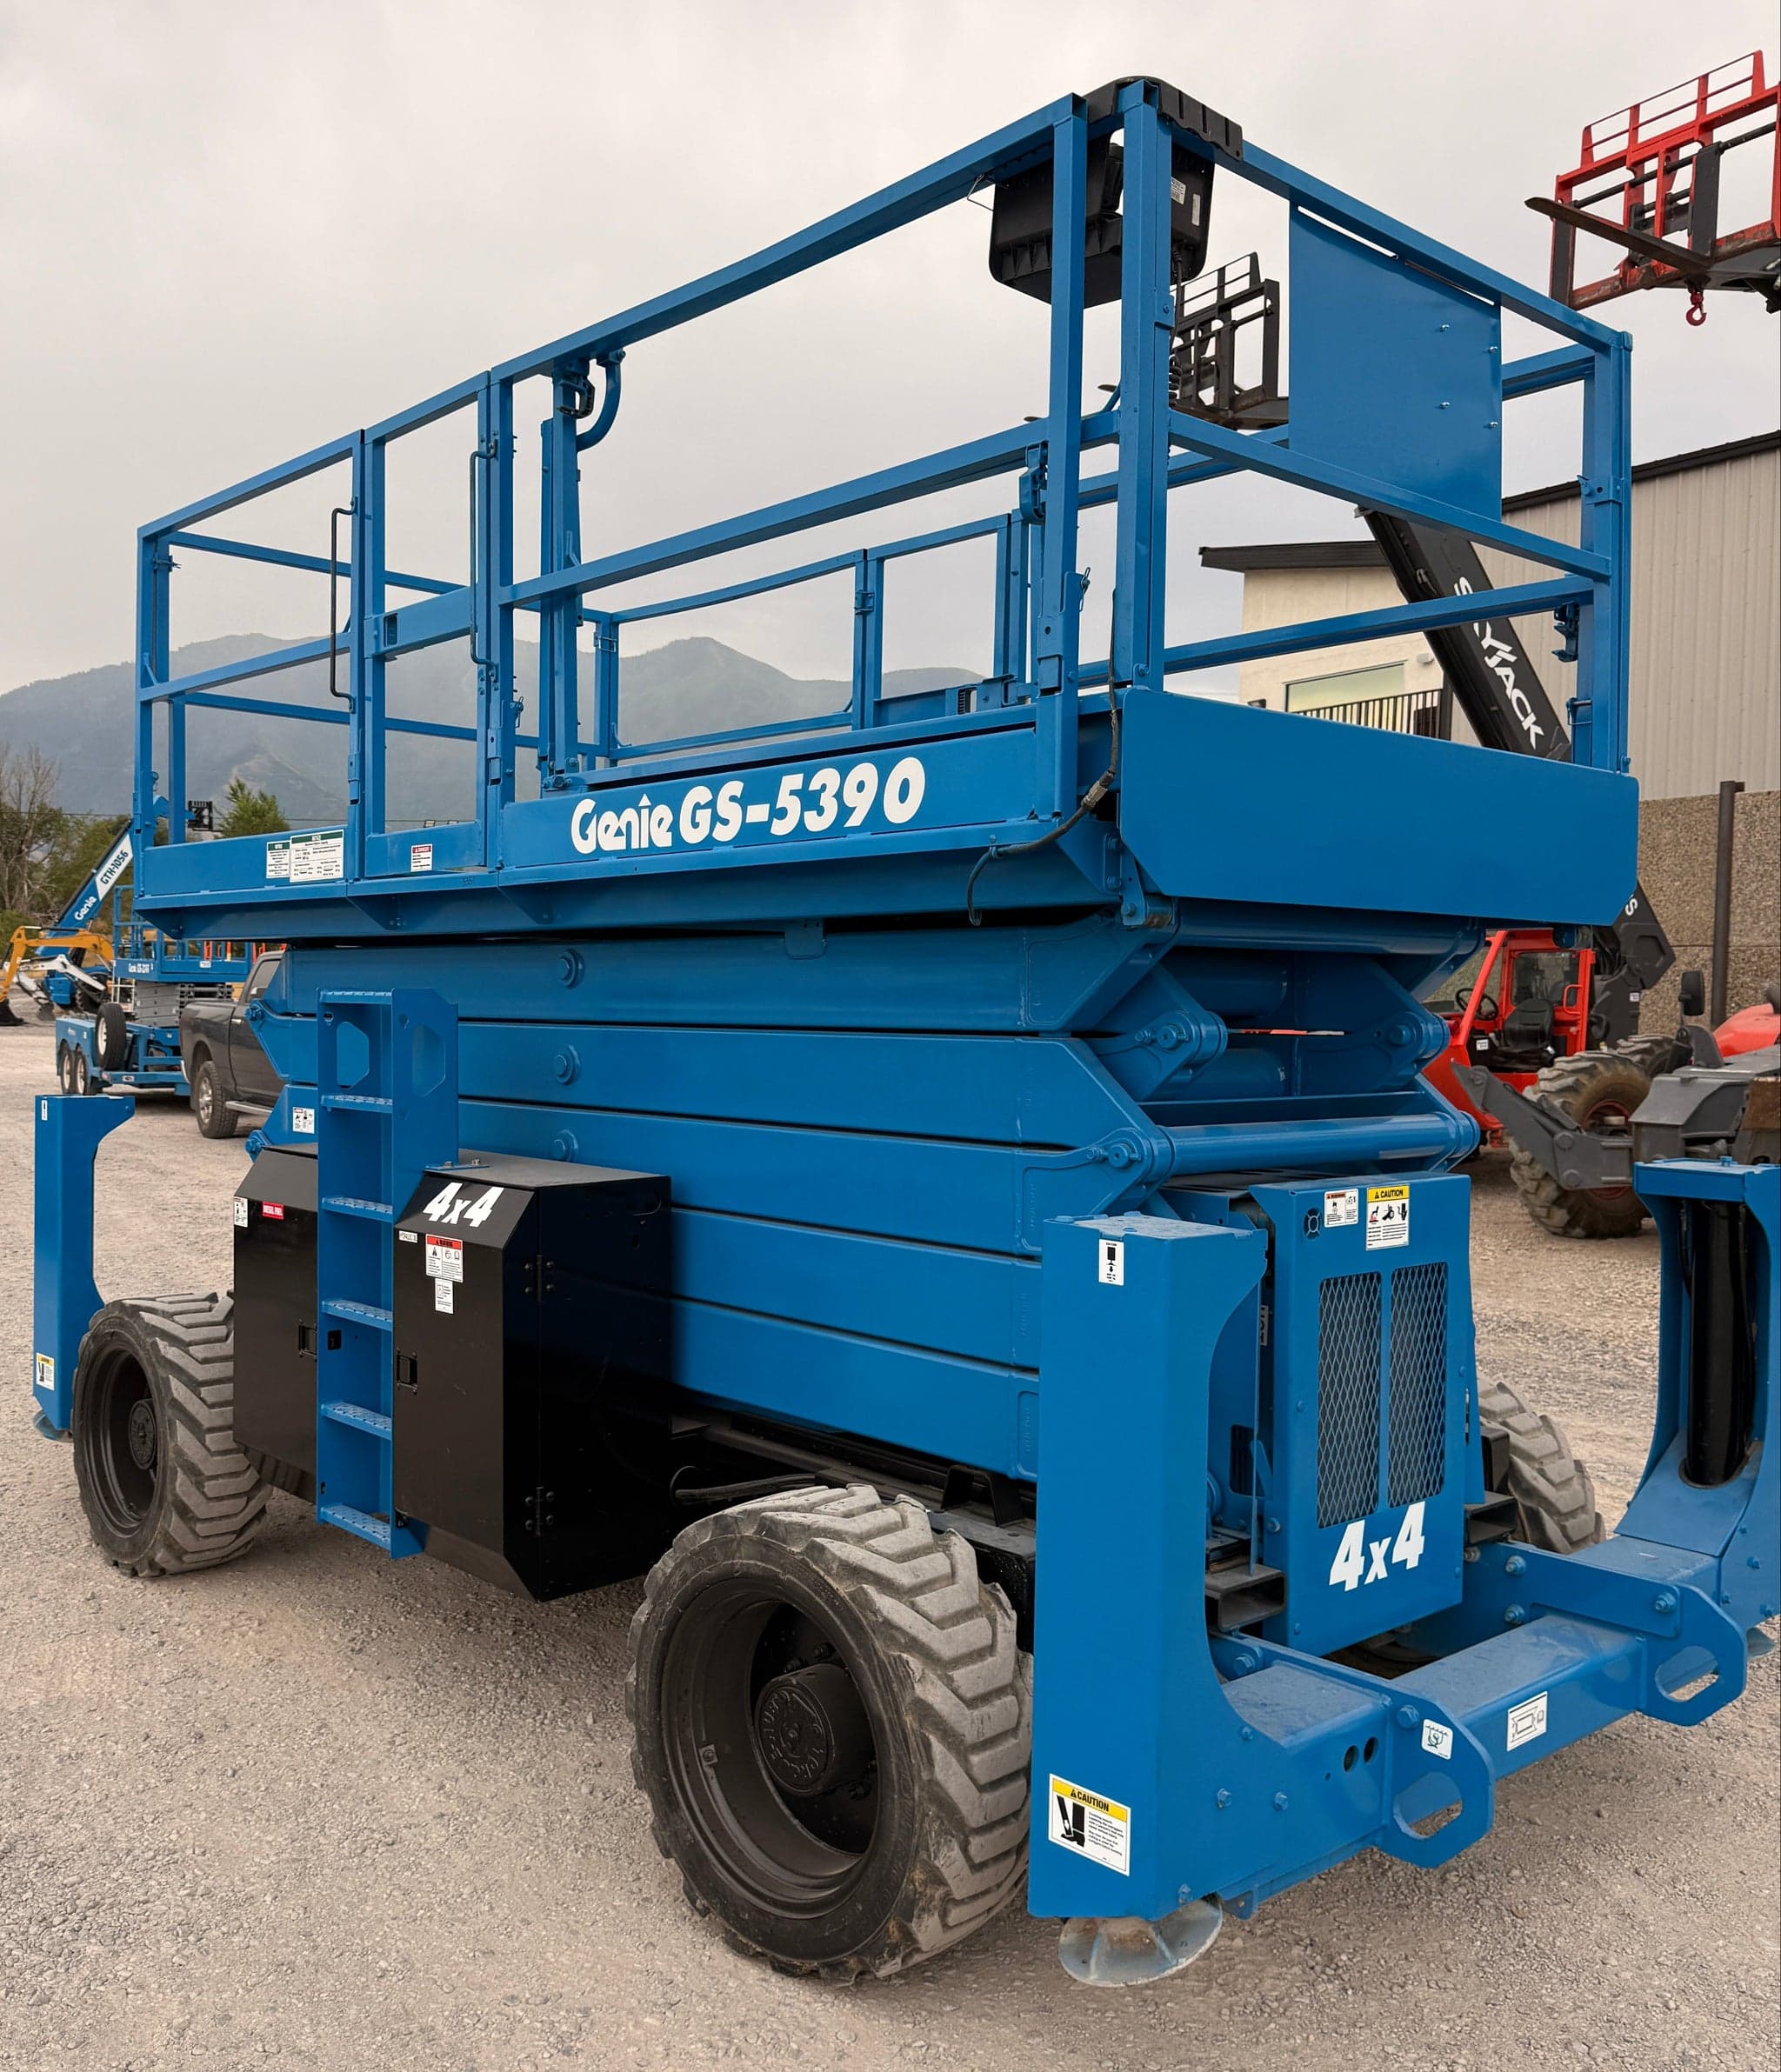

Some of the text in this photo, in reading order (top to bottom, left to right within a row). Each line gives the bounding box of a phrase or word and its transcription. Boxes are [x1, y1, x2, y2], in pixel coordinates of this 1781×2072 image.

[1454, 576, 1544, 750] SYJACK
[571, 756, 925, 854] Genie GS-5390
[100, 849, 129, 885] GTH-1056
[74, 896, 97, 920] Genie
[423, 1182, 504, 1228] 4x4
[1380, 1189, 1404, 1198] CAUTION
[1329, 1500, 1426, 1592] 4x4
[1077, 1790, 1110, 1812] CAUTION
